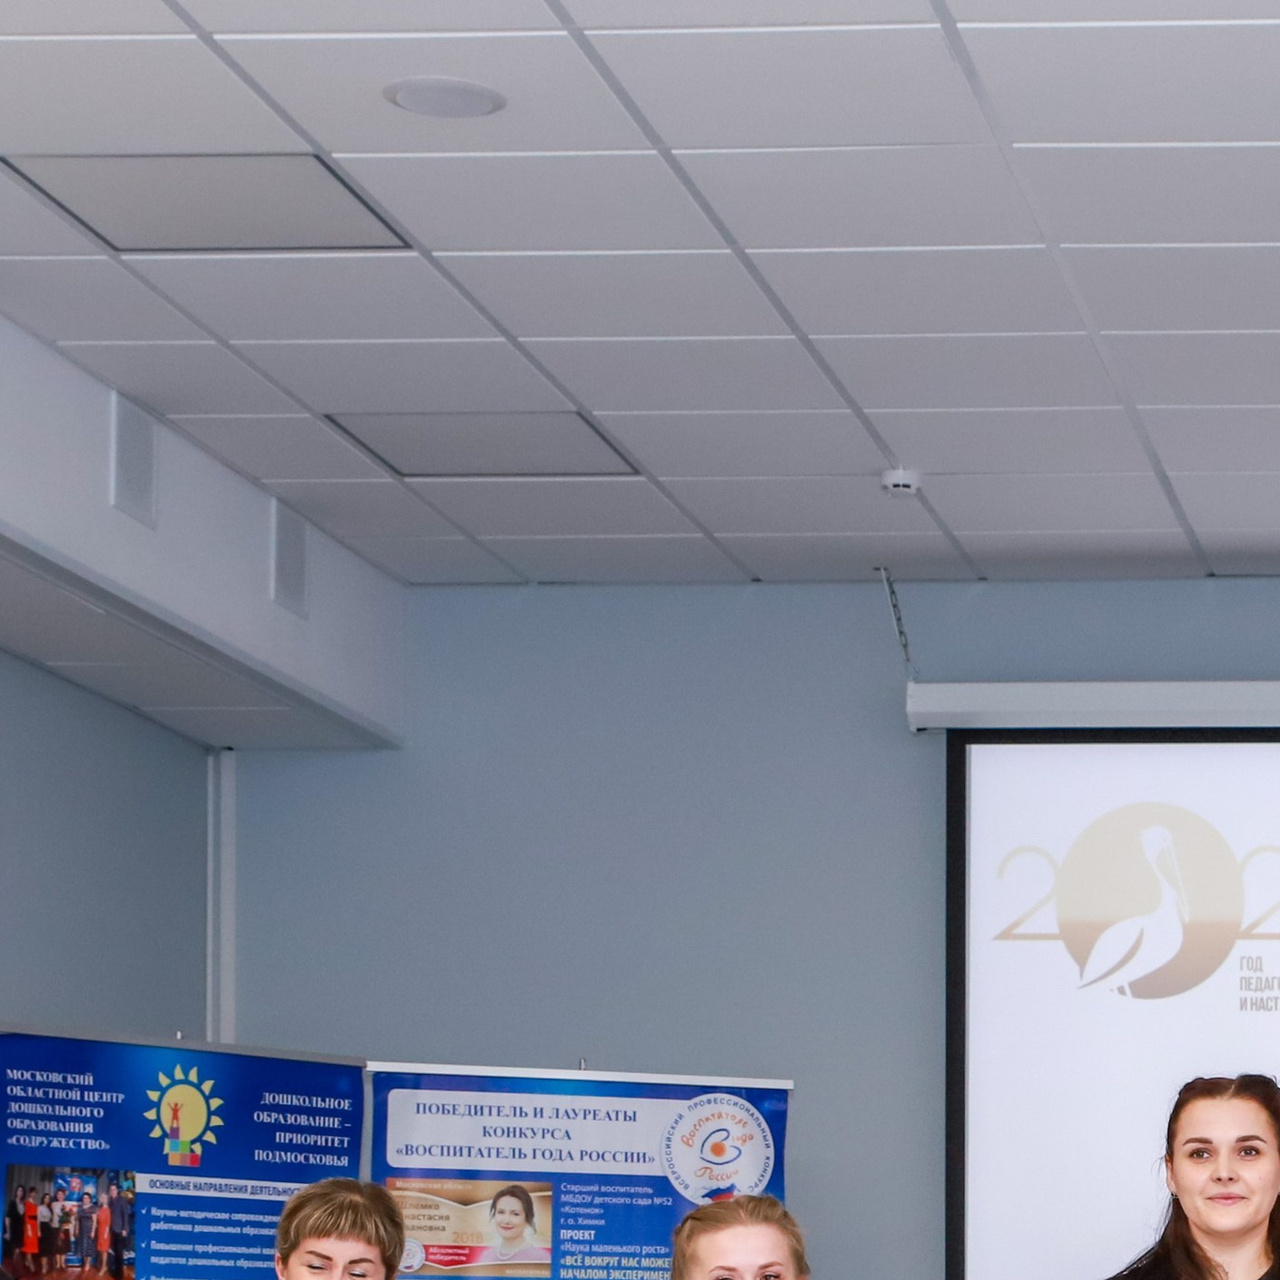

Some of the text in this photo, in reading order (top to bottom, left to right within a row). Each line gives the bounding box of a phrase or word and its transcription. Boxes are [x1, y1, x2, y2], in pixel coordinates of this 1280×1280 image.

[1239, 955, 1264, 973] ГОД
[1239, 997, 1249, 1012] И
[6, 1068, 94, 1085] МОСКОВСКИЙ
[7, 1085, 125, 1103] ОБЛАСТНОЙ ЦЕНТР
[261, 1092, 352, 1110] ДОШКОЛЬНОЕ
[7, 1102, 104, 1118] ДОШКОЛЬНОГО
[415, 1102, 638, 1123] ПОБЕДИТЕЛЬ И ЛАУРЕАТЫ
[7, 1118, 94, 1133] ОБРАЗОВАНИЯ
[253, 1111, 342, 1128] ОБРАЗОВАНИЕ
[275, 1131, 350, 1148] ПРИОРИТЕТ
[482, 1125, 572, 1141] КОНКУРСА
[7, 1134, 110, 1150] «СОДРУЖЕСТВО»
[664, 1112, 691, 1191] ВСЕРОССИЙСКИЙ
[687, 1097, 771, 1149] ПРОФЕССИОНАЛЬНЫЙ
[747, 1155, 771, 1193] КОНКУРС
[254, 1149, 348, 1167] ПОДМОСКОВЬЯ
[396, 1144, 656, 1164] «ВОСПИТАТЕЛЬ ГОДА РОССИИ»
[149, 1179, 191, 1190] ОСНОВНЫЕ
[193, 1181, 248, 1194] НАПРАВЛЕНИЯ
[560, 1182, 654, 1194] Старший воспитатель
[561, 1194, 673, 1206] МБДОУ детского сада №52
[561, 1205, 604, 1214] «Котенок»
[577, 1217, 605, 1226] Химки
[560, 1229, 596, 1240] ПРОЕКТ
[561, 1241, 669, 1256] «Наука маленького роста»
[584, 1256, 619, 1267] ВОКРУГ
[621, 1257, 640, 1267] НАС
[641, 1258, 673, 1268] МОЖЕ
[560, 1268, 607, 1280] НАЧАЛОМ
